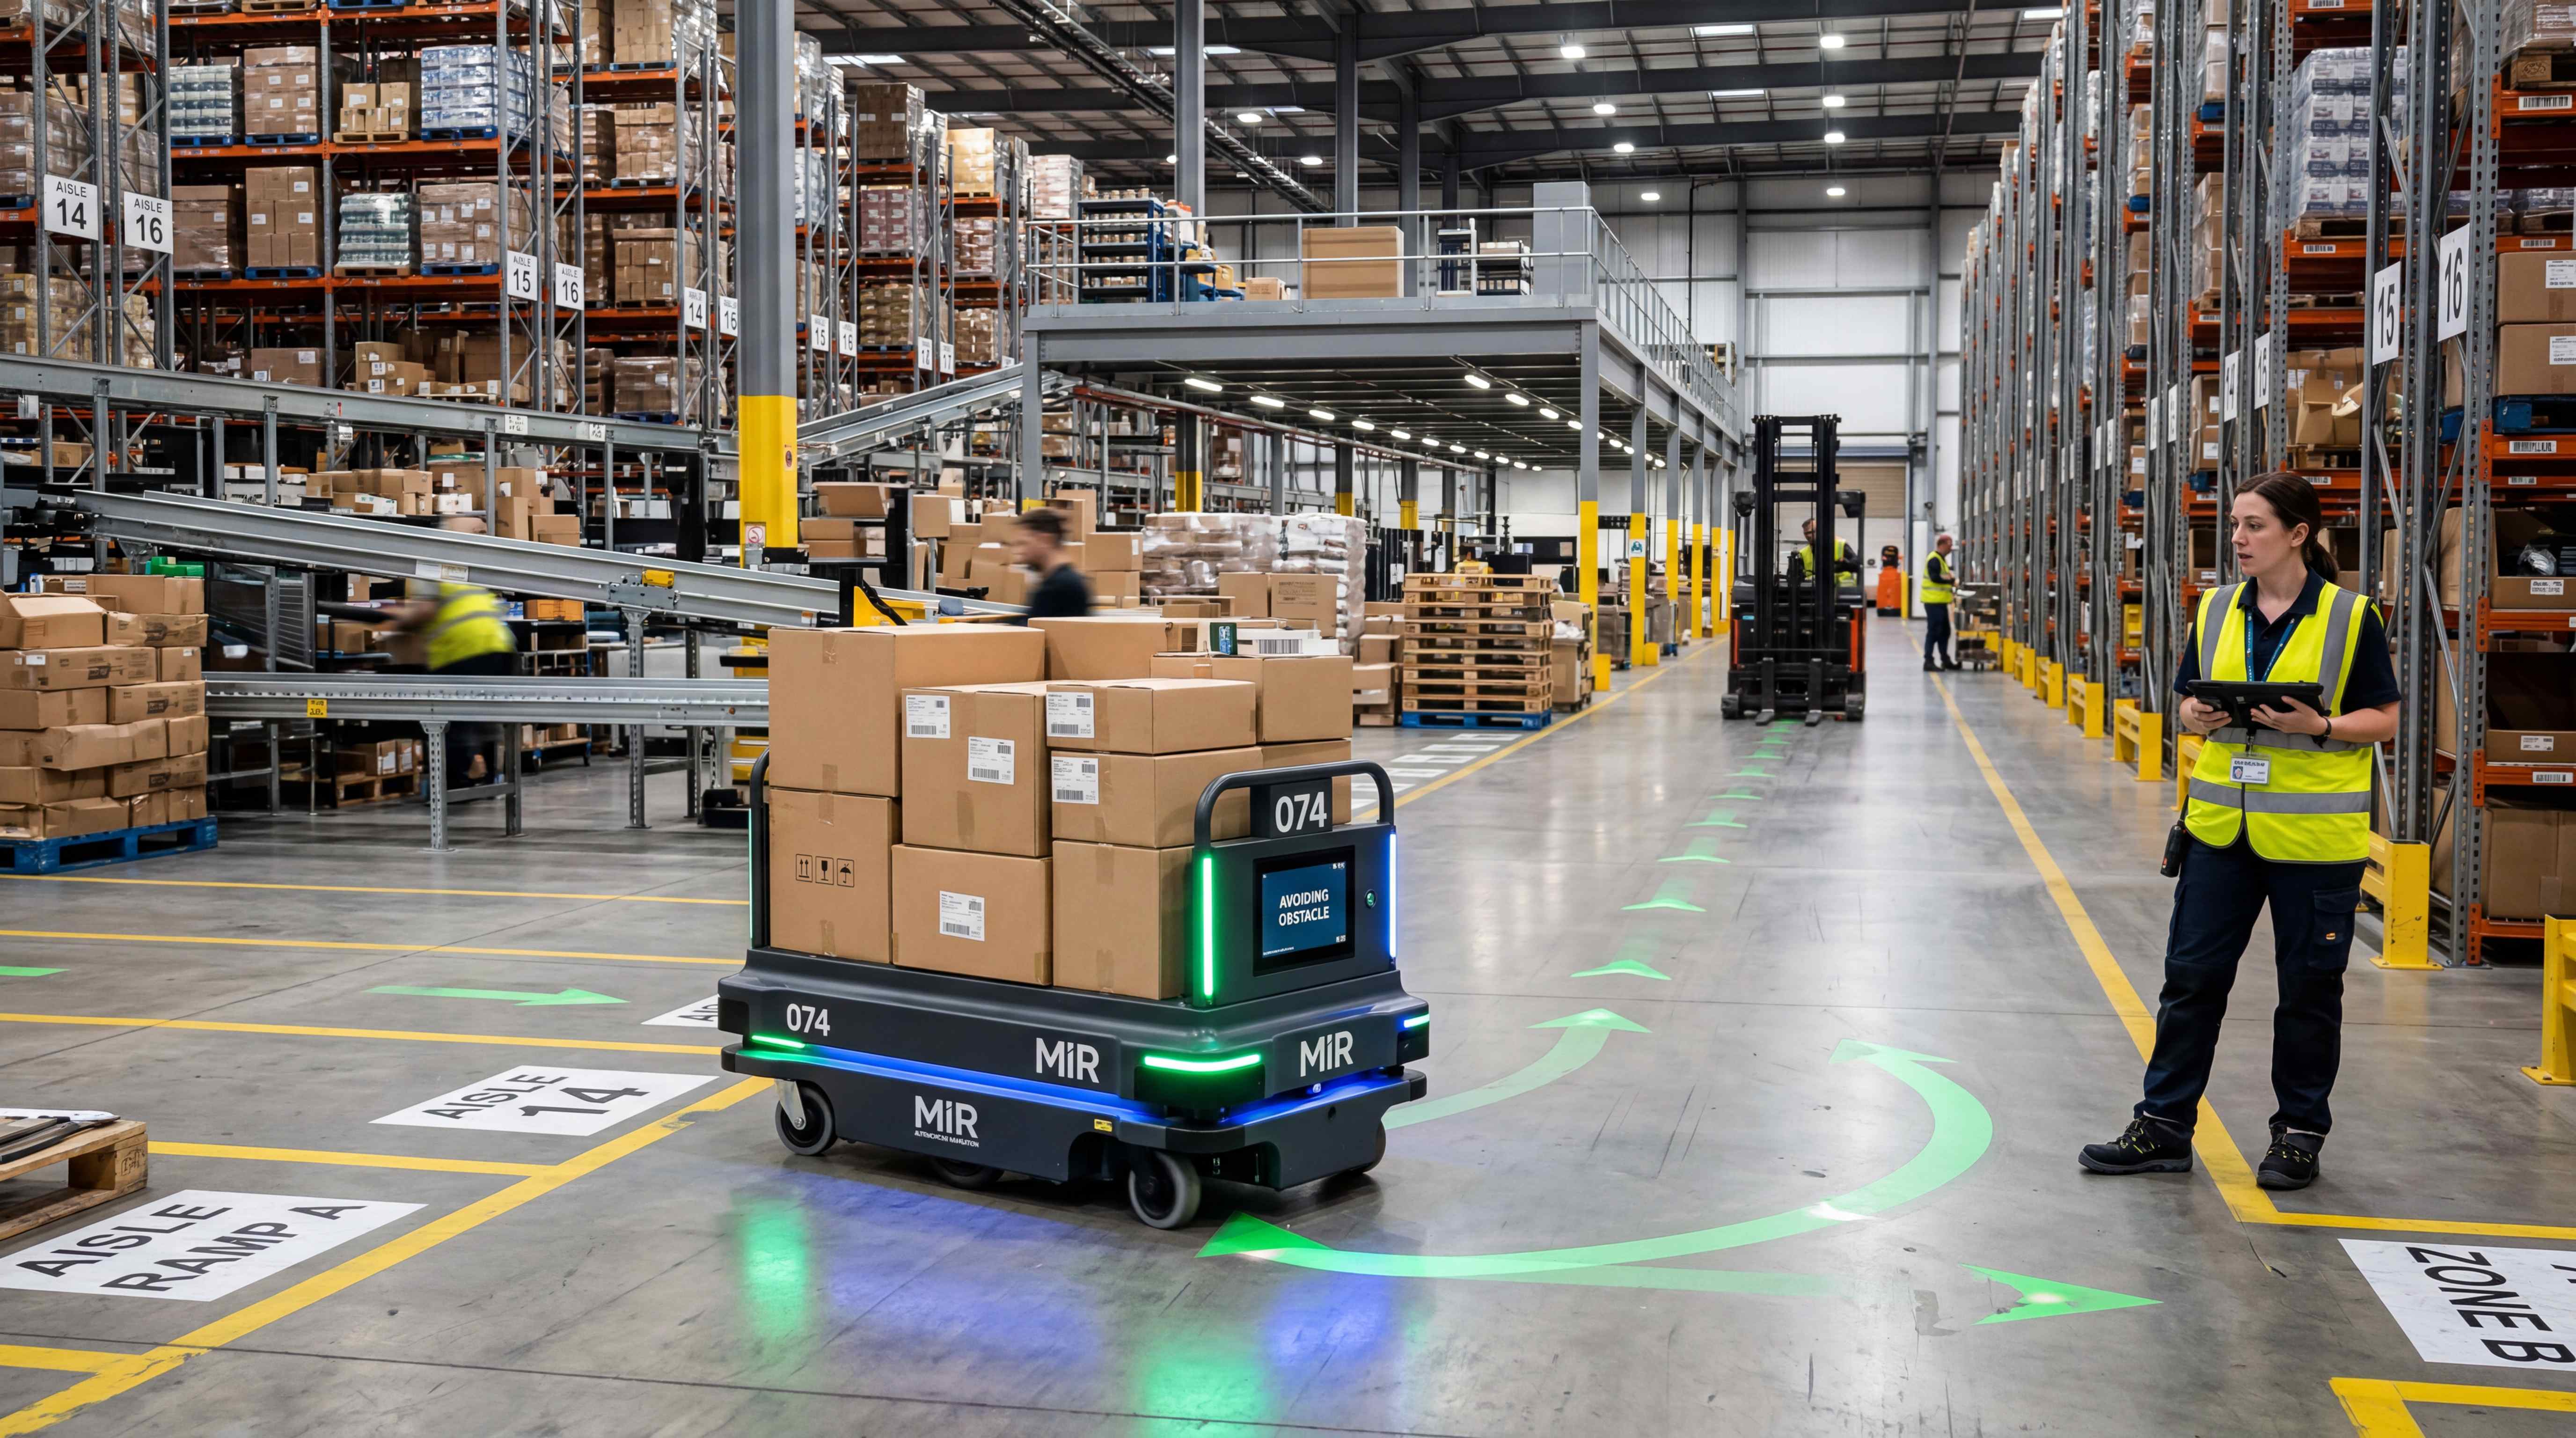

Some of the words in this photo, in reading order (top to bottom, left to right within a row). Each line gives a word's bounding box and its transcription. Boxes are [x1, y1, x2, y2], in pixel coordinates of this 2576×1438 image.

[56, 181, 87, 198] AISLE
[57, 198, 87, 229] 14
[134, 198, 162, 213] AISLE
[136, 214, 163, 244] 16
[513, 268, 530, 293] 15
[563, 280, 578, 303] 16
[2444, 247, 2462, 323] 16
[689, 302, 703, 323] 14
[724, 311, 737, 330] 16
[2378, 283, 2395, 349] 15
[815, 327, 825, 346] 15
[1275, 791, 1327, 833] 074
[1279, 888, 1329, 909] AVOIDING
[1279, 906, 1330, 926] OBSTACLE
[786, 1003, 831, 1036] 074
[1036, 1038, 1100, 1083] MiR
[1300, 1031, 1354, 1077] MiR
[423, 1074, 568, 1120] AISLE
[519, 1087, 649, 1116] 14
[915, 1095, 979, 1138] MiR
[16, 1204, 233, 1278] AISLE
[101, 1222, 298, 1291] RAMP
[289, 1205, 367, 1220] A
[2405, 1247, 2553, 1332] ZONE
[2481, 1339, 2576, 1363] B
